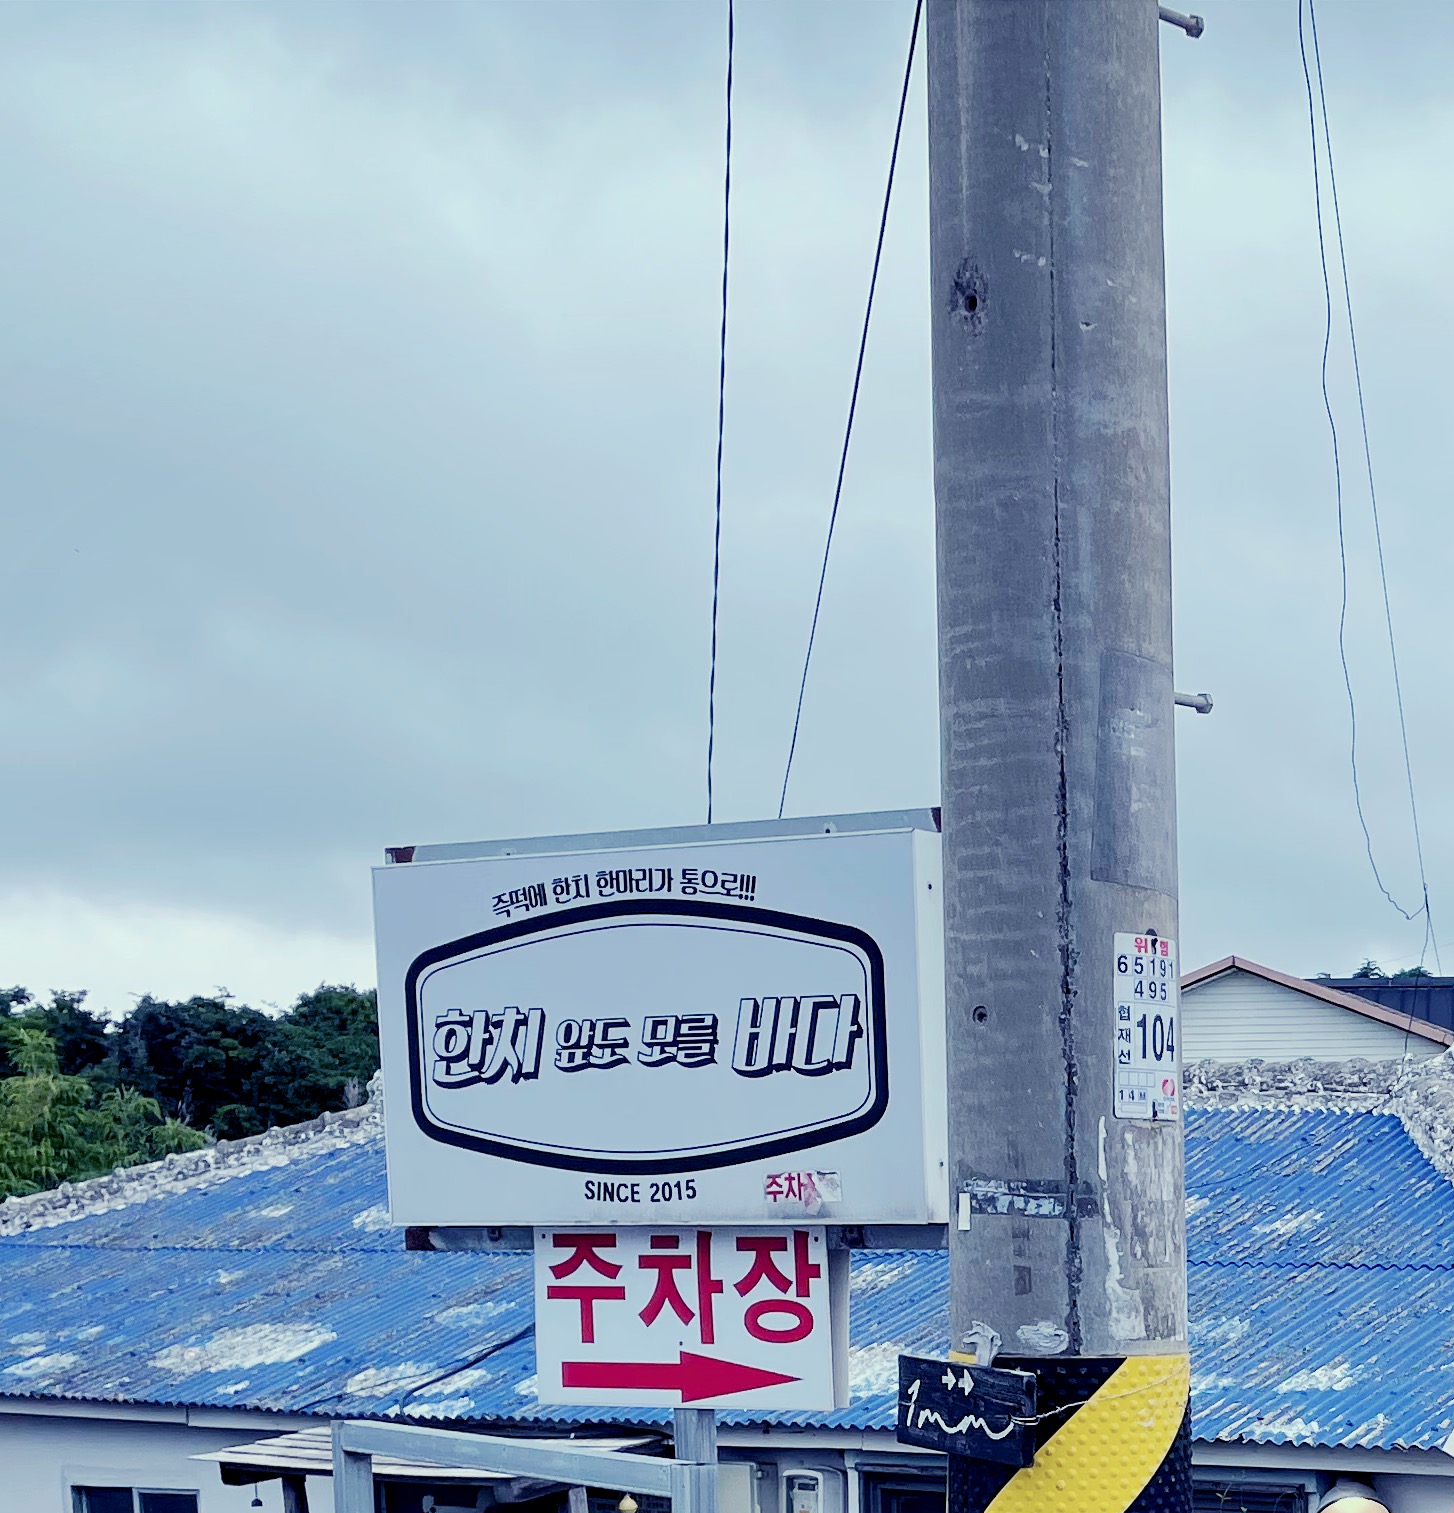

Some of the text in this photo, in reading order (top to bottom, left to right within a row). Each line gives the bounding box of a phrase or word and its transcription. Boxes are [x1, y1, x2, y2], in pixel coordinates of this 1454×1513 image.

[492, 867, 757, 918] 즉떡에 한치 한마리가 통으로!!!
[1134, 980, 1167, 1001] 495
[432, 993, 864, 1090] 한치 앞도 모를 바다
[1136, 1013, 1175, 1063] 104
[584, 1178, 697, 1203] SINCE 2015
[765, 1172, 819, 1204] 주차
[546, 1229, 822, 1345] 주차장
